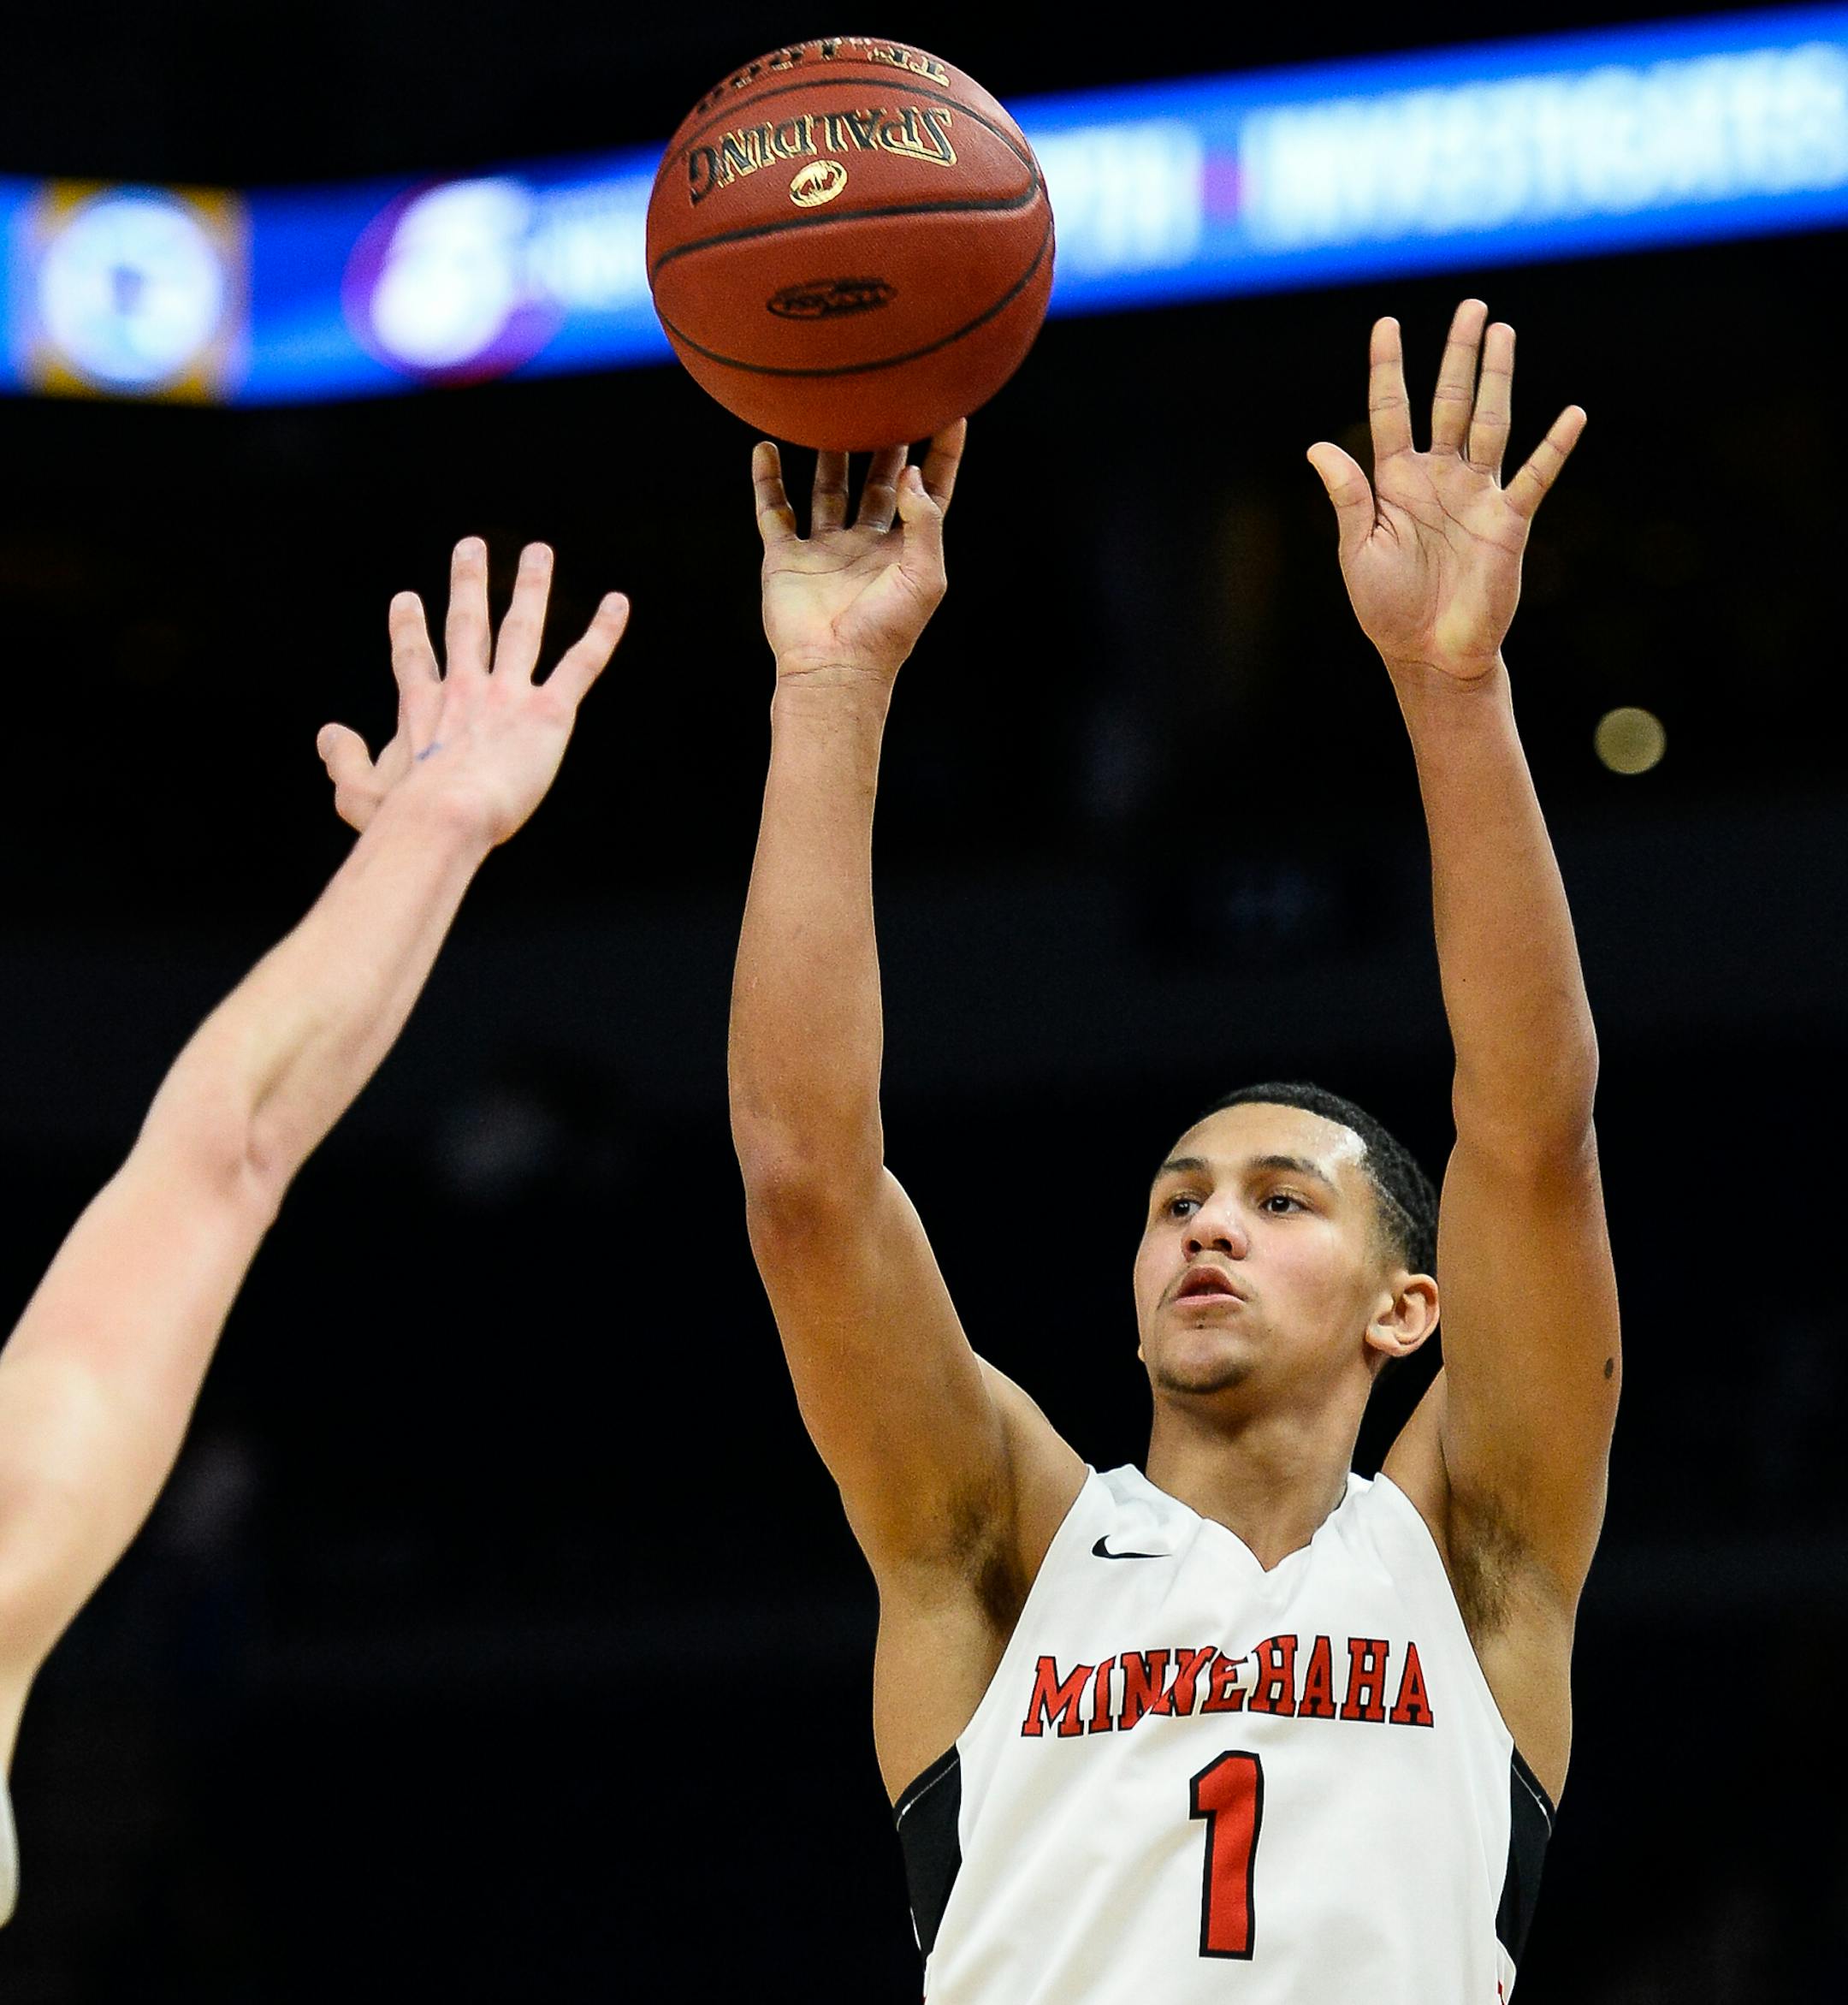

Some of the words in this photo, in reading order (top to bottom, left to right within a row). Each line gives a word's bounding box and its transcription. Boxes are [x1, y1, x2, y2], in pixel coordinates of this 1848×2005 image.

[689, 106, 957, 206] SPALDING
[1022, 1634, 1435, 1738] MINNEHAHA
[1189, 1750, 1265, 1961] 1
